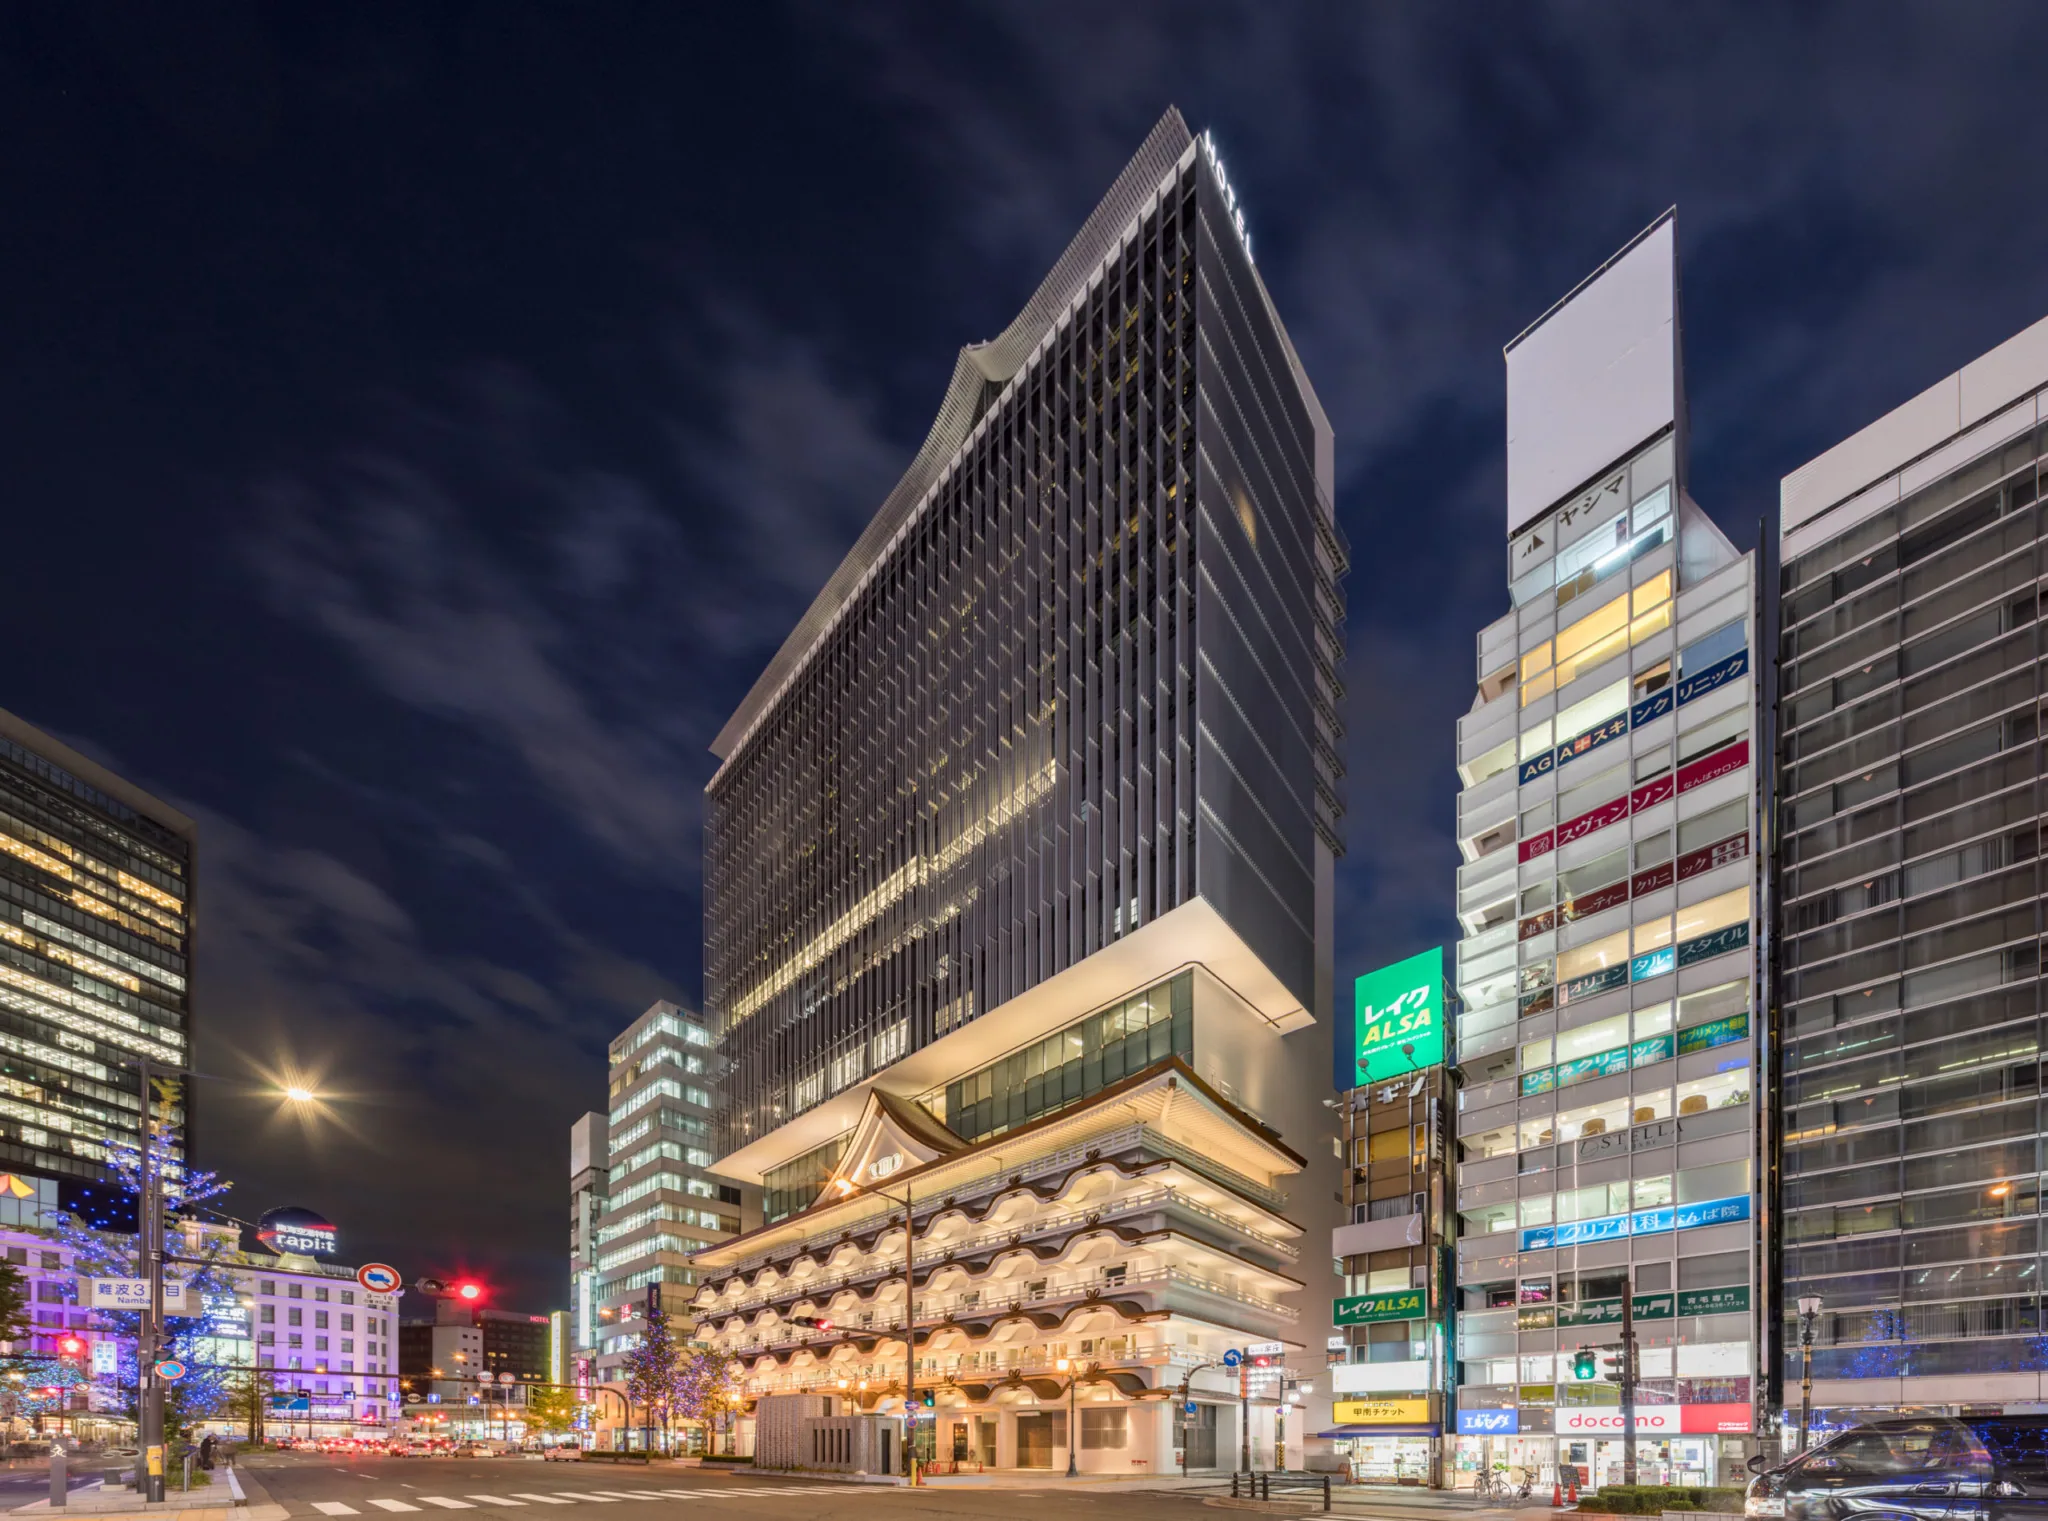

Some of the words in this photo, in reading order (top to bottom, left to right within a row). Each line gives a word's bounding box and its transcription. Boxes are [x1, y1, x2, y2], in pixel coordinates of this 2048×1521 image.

[1205, 129, 1254, 264] HOTEL
[1559, 475, 1625, 526] ヤシマ
[1523, 745, 1574, 780] AGA
[1592, 655, 1745, 746] スキンクリニック
[1559, 784, 1673, 846] スヴェンソン
[1683, 759, 1742, 790] なんばサロン
[1365, 985, 1431, 1026] レイク
[1363, 1008, 1432, 1047] ALSA
[1601, 1121, 1684, 1148] STELLA
[1563, 1213, 1661, 1243] クリア歯科
[1670, 1205, 1741, 1229] なんば院
[276, 1234, 336, 1253] rapi:t
[98, 1283, 180, 1297] 難波3目
[529, 1315, 550, 1324] HOTEL
[1353, 1407, 1406, 1417] 甲南チケット
[1569, 1413, 1666, 1428] docomo
